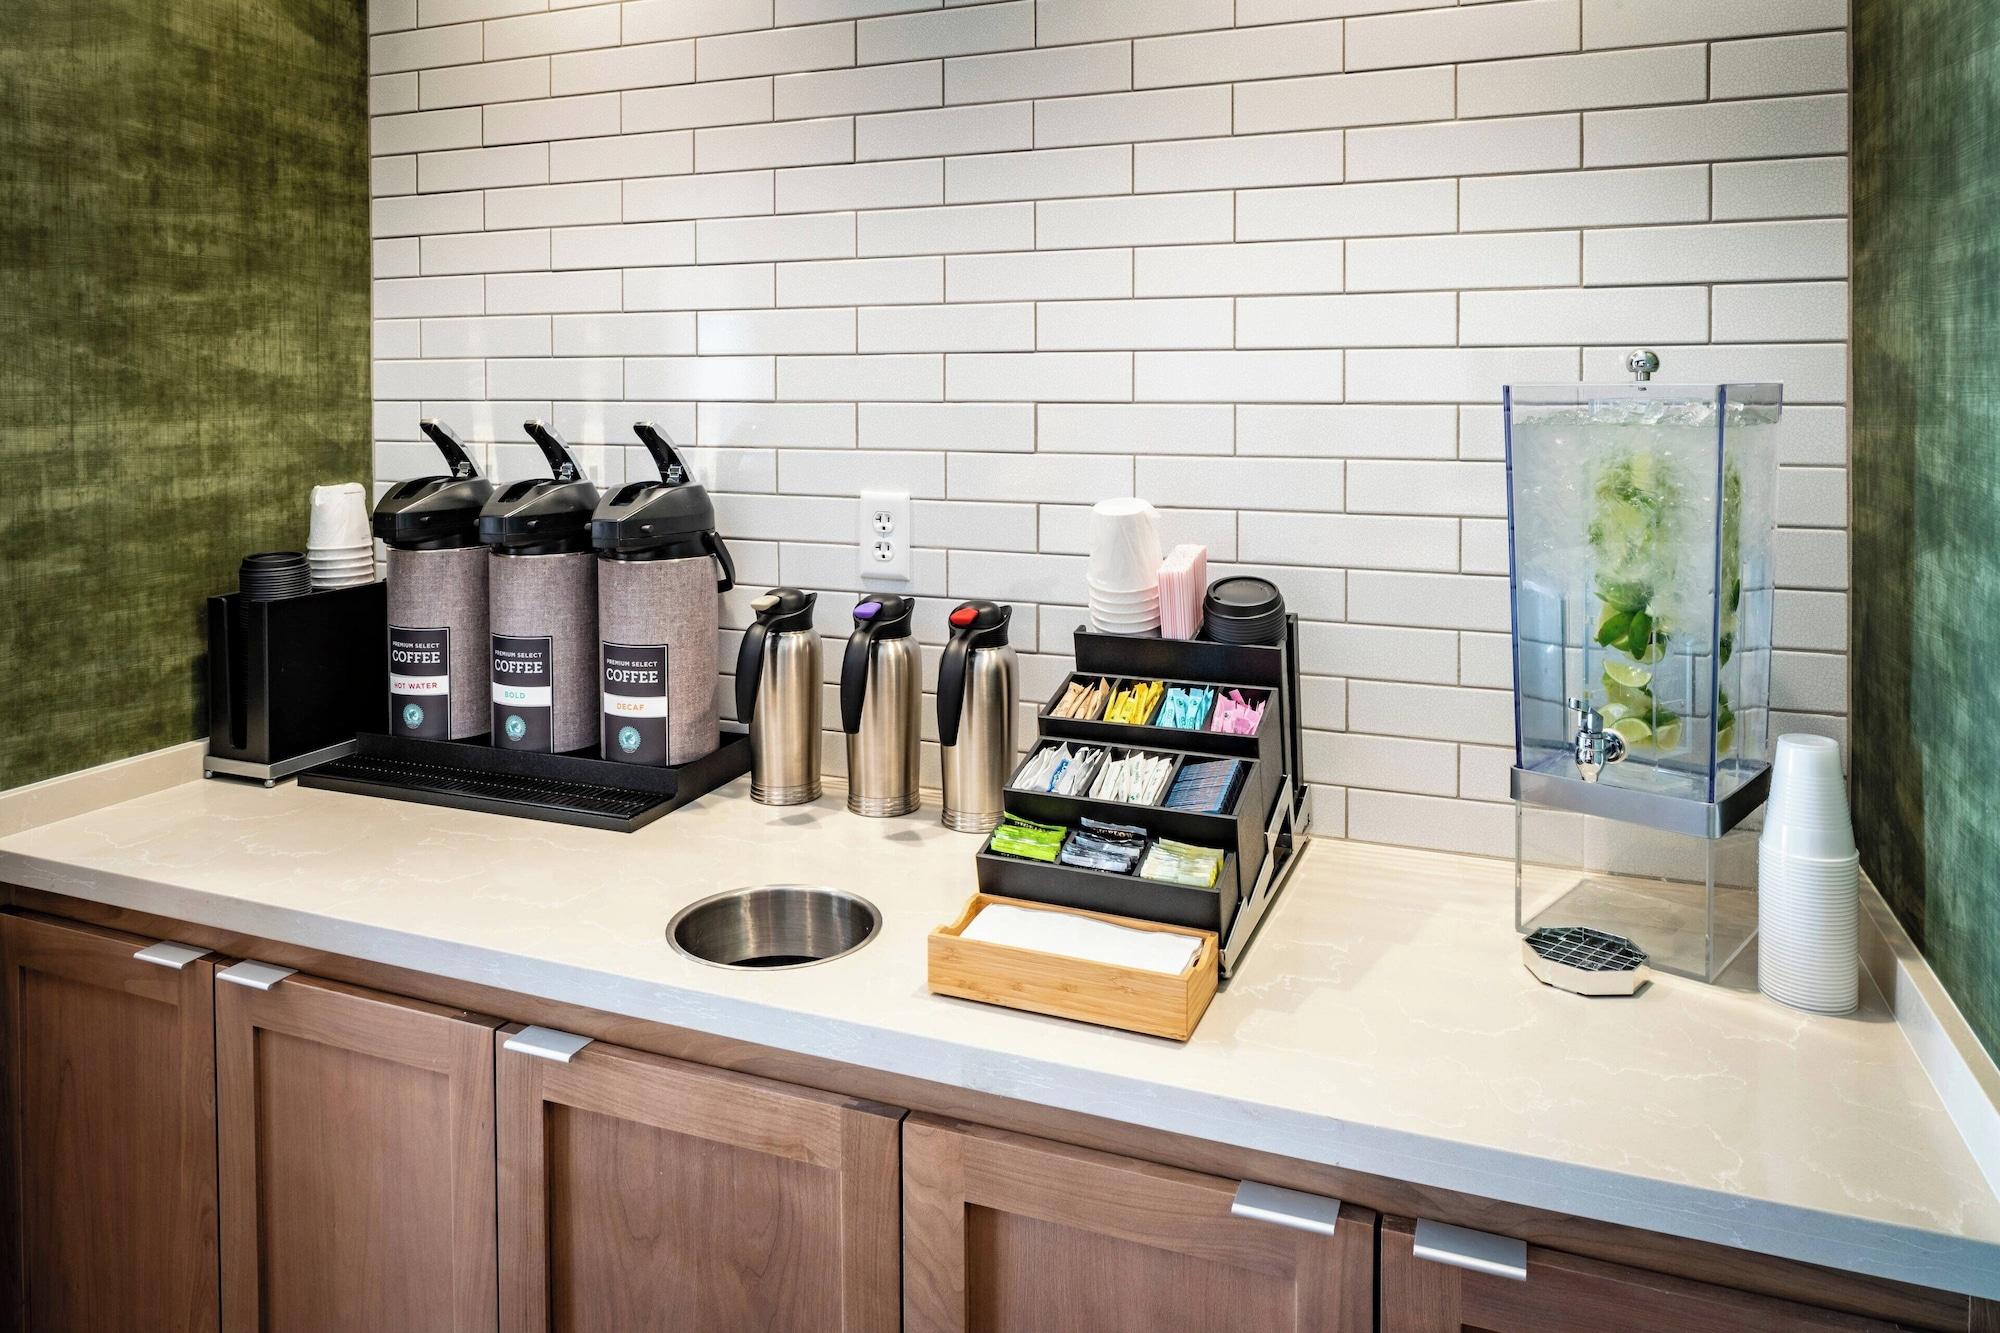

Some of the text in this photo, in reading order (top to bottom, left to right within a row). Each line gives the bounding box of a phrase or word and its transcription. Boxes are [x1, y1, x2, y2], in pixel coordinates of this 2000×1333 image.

[392, 640, 414, 649] PREMIUM
[392, 649, 440, 664] COFFEE
[494, 650, 516, 658] PREMIUM
[494, 659, 543, 674] COFFEE
[606, 658, 630, 667] PREMIUM
[606, 668, 658, 683] COFFEE
[504, 691, 526, 699] BOLD
[616, 703, 645, 711] DECAF
